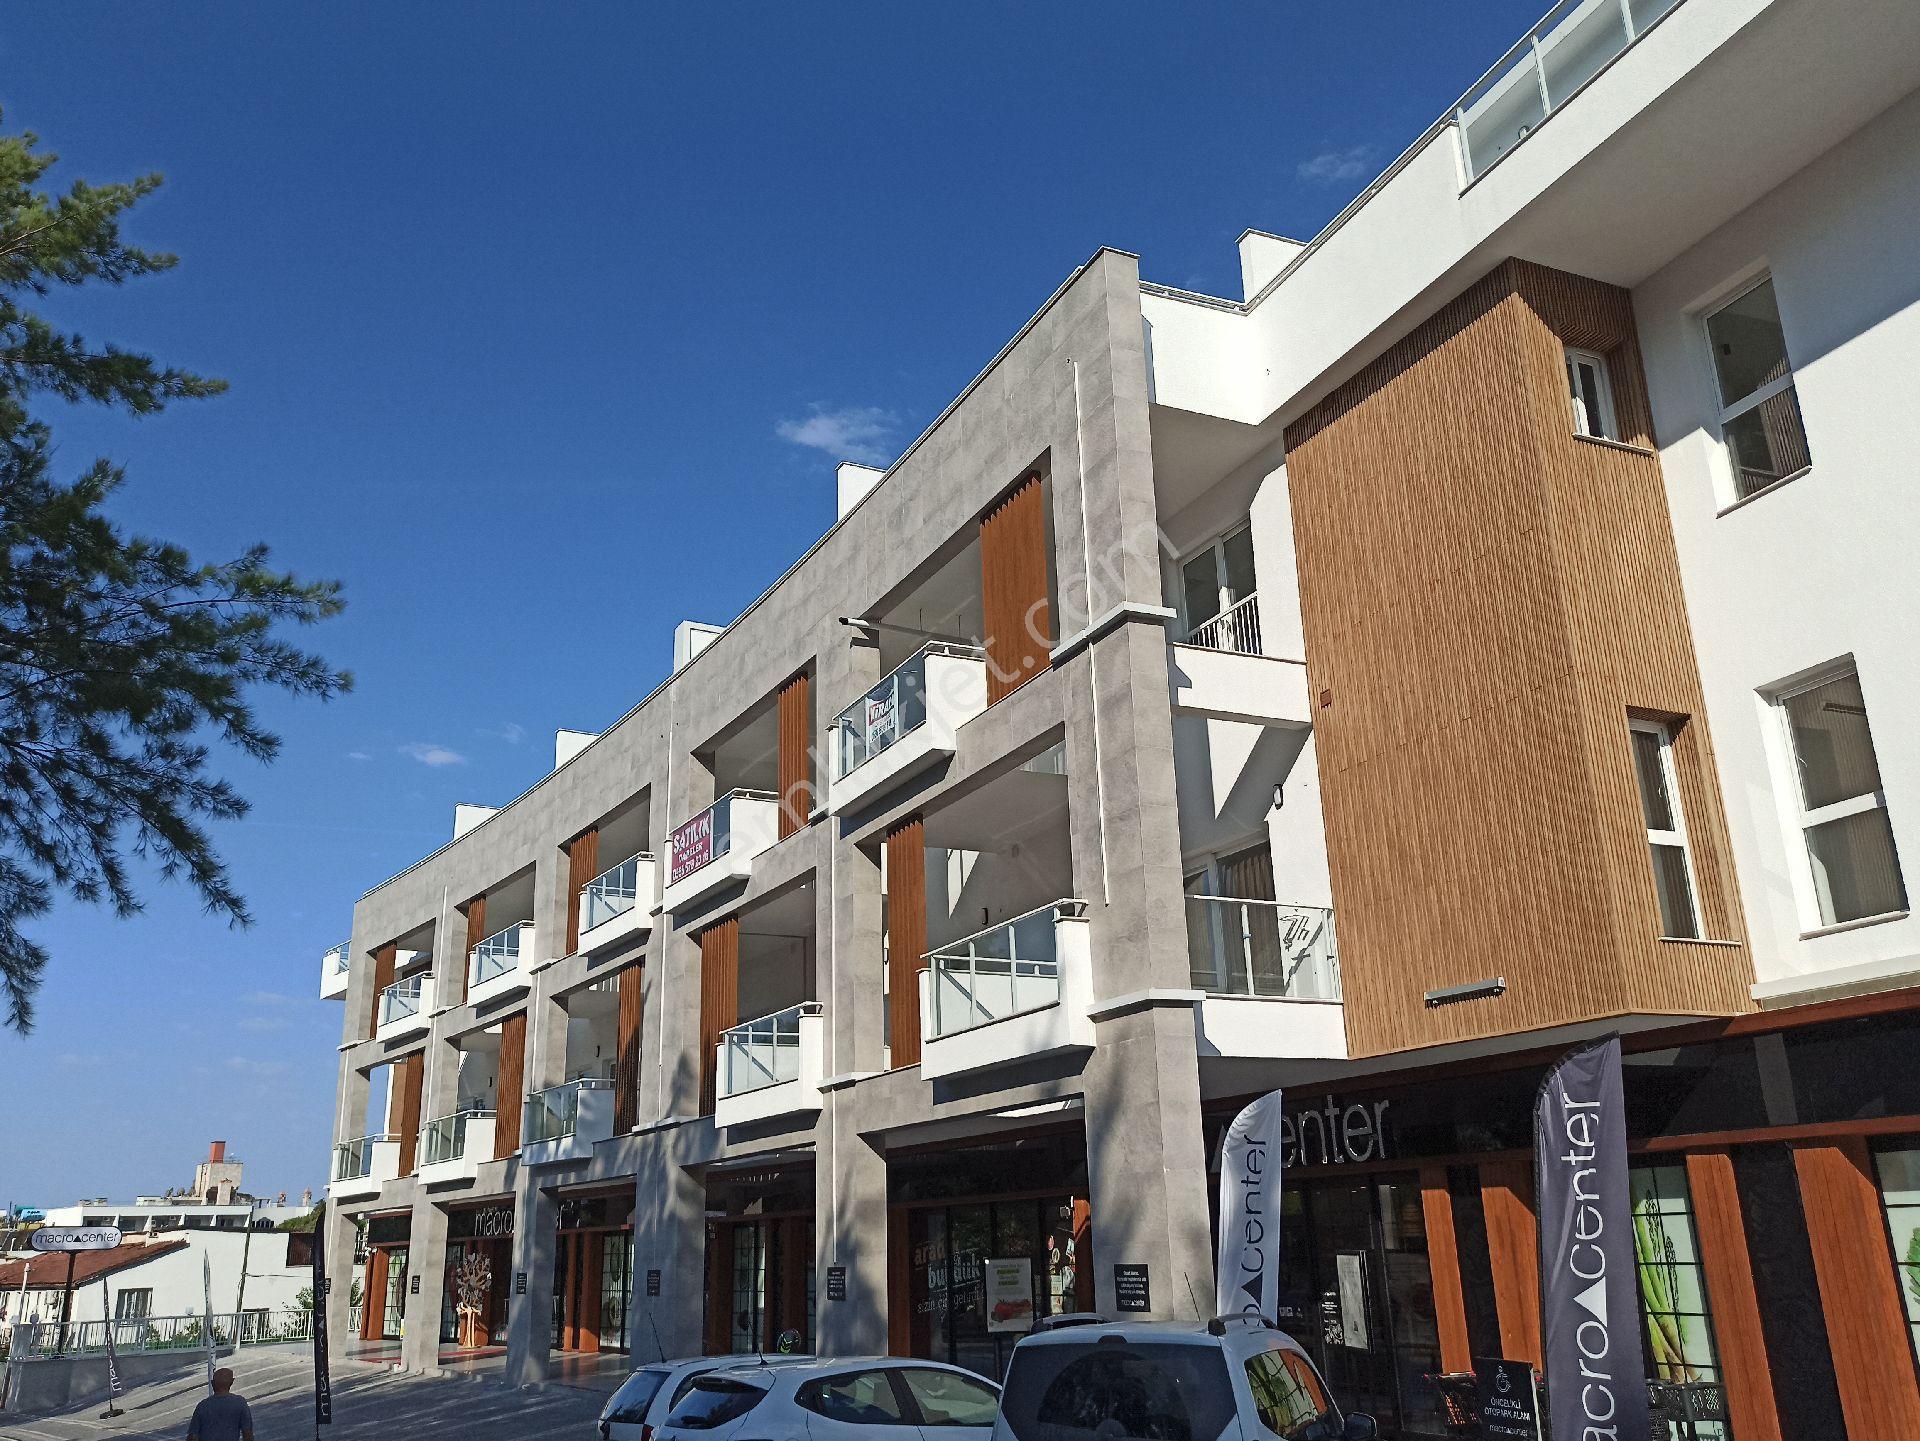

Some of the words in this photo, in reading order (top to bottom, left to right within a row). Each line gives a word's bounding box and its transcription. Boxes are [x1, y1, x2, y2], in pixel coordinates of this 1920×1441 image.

[673, 814, 710, 854] SATILIK
[1281, 1094, 1389, 1169] enter
[475, 1210, 513, 1236] macro
[1241, 1133, 1266, 1273] center
[1561, 1092, 1606, 1279] center
